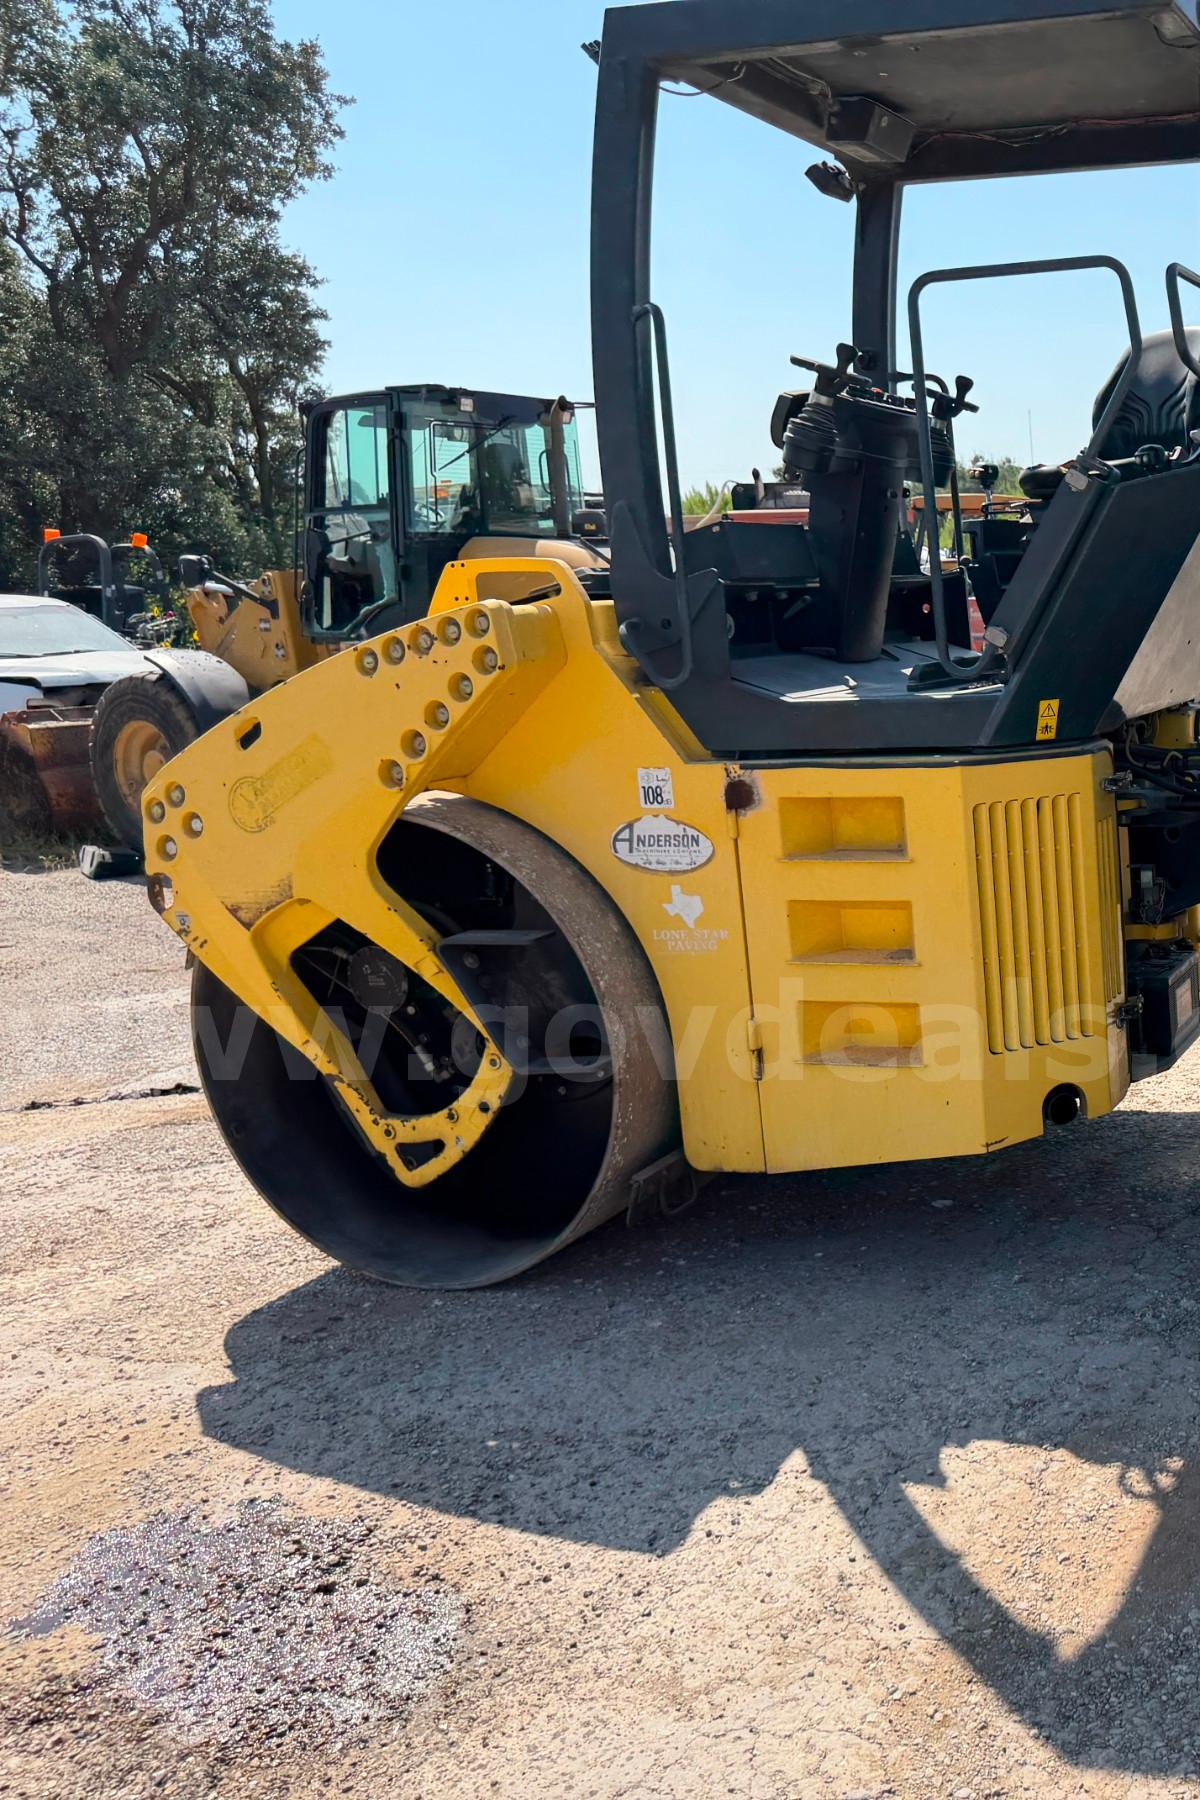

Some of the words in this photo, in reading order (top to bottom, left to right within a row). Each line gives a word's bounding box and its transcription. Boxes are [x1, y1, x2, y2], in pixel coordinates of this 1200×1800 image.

[641, 785, 664, 806] 108
[612, 822, 700, 854] ANDERSON
[653, 928, 689, 940] LONE
[694, 928, 729, 940] STAR
[667, 940, 718, 952] PAVING
